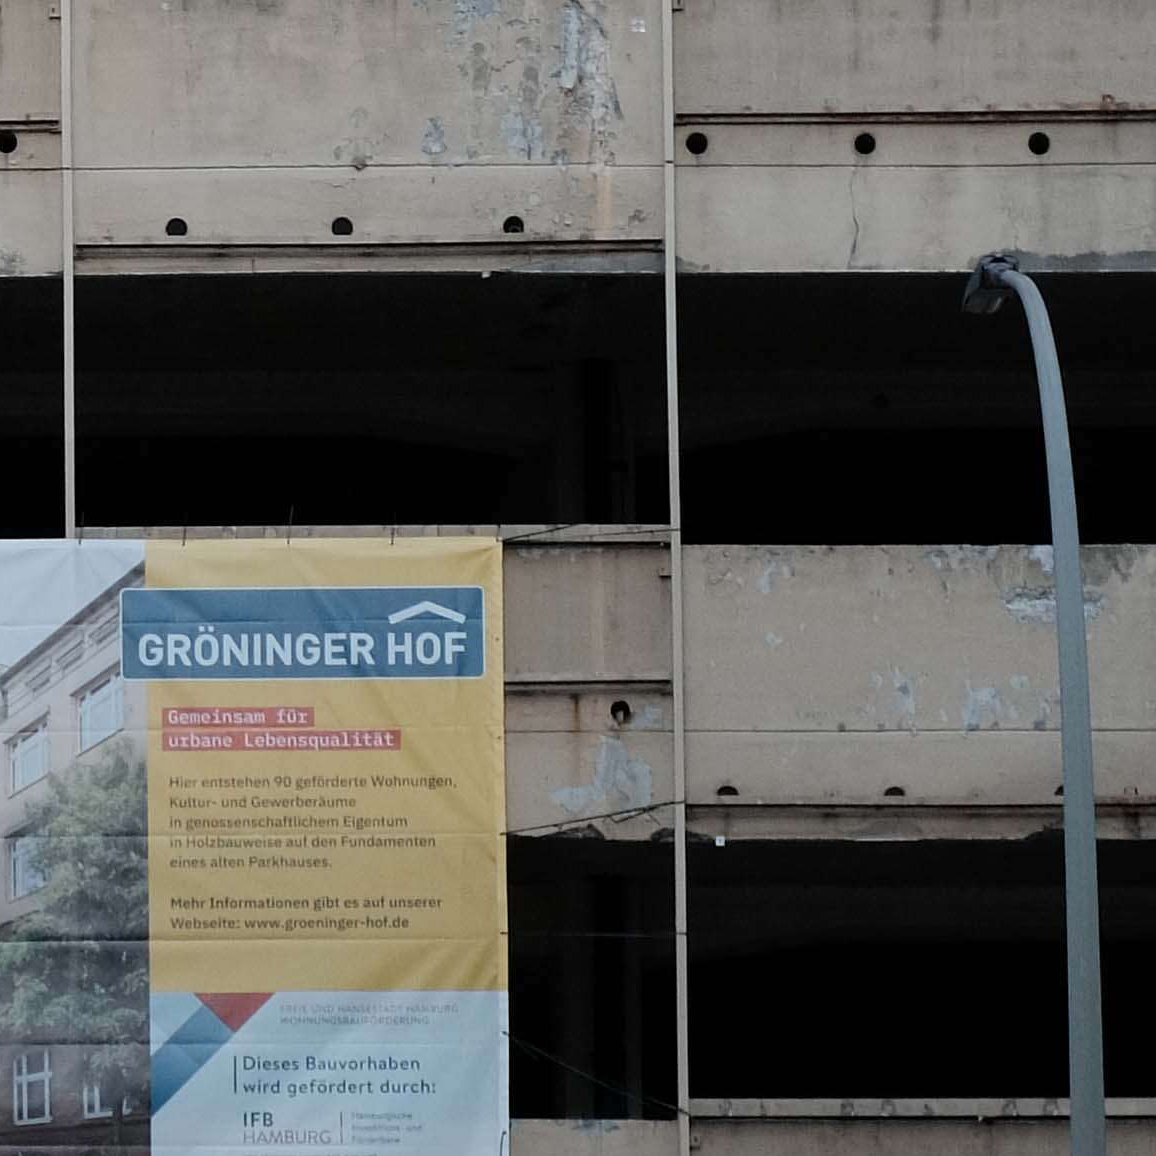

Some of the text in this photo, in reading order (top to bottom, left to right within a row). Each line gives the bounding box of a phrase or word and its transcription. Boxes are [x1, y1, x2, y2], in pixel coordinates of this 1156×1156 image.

[138, 625, 468, 667] GRÖNINGER HOF
[167, 708, 309, 725] Gemeinsam für
[168, 731, 395, 750] urbane Lebensqualität
[169, 775, 458, 791] Hier entstehen 90 geförderte Wohnungen,
[169, 796, 357, 809] Kultur- und Gewerberäume
[169, 815, 409, 831] in genossenschaftlichem Eigentum
[170, 835, 436, 849] in Holzbauweise auf den Fundamenten
[170, 856, 333, 869] eines alten Parkhauses.
[170, 897, 444, 911] Mehr Informationen gibt es auf unserer
[170, 917, 410, 931] Webseite: www.groeninger-hof.de
[243, 1055, 421, 1071] Dieses Bauvorhaben
[243, 1079, 437, 1098] wird gefördert durch:
[244, 1112, 274, 1128] IFB
[244, 1130, 332, 1145] HAMBURG
